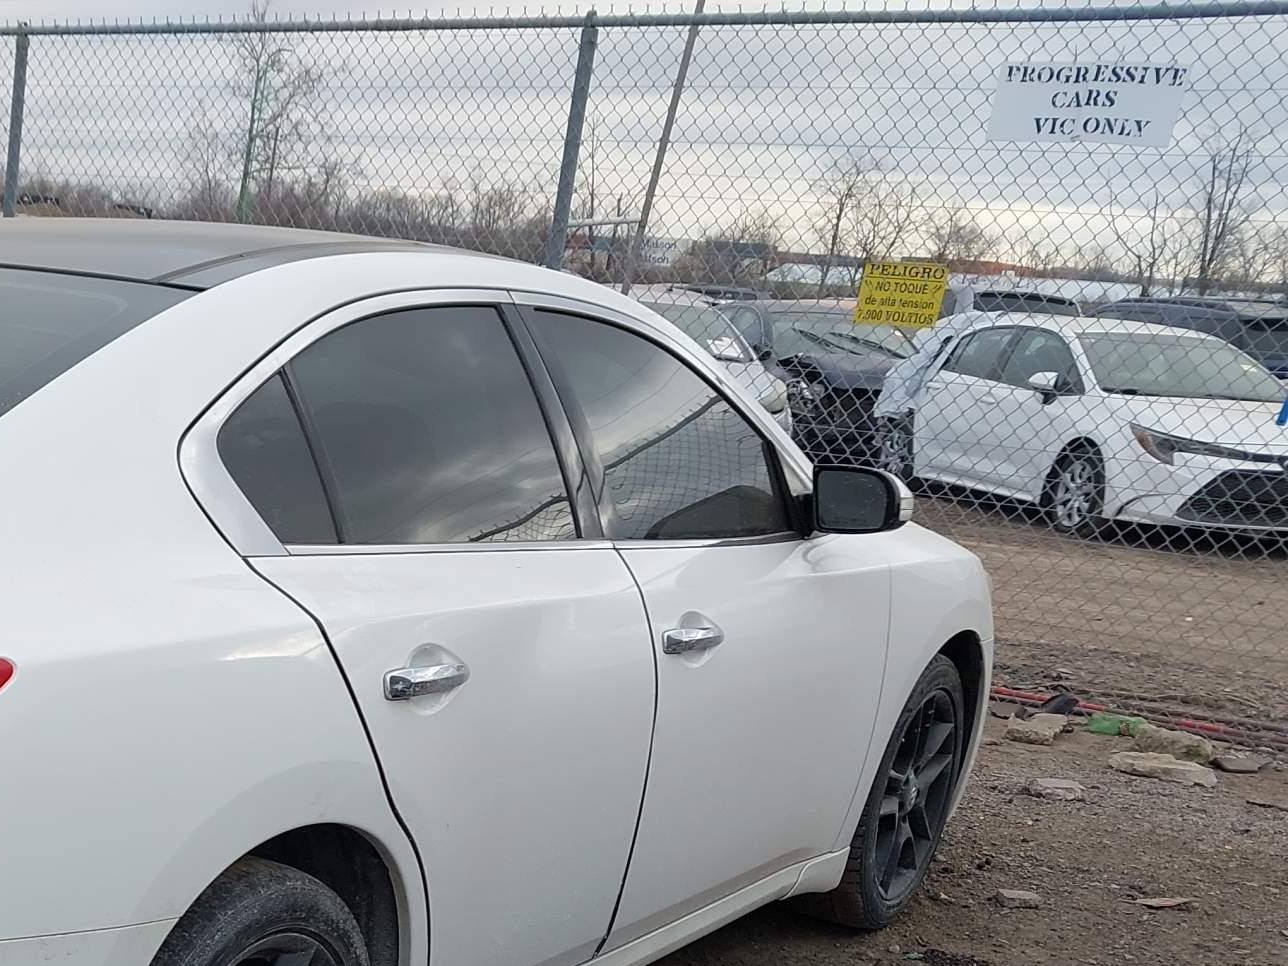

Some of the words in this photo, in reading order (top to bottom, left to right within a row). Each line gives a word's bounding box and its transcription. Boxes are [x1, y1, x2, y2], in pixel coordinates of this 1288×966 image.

[1005, 64, 1187, 87] PROGRESSIVE
[1051, 89, 1118, 108] CARS
[1034, 117, 1076, 136] VIC
[1082, 117, 1152, 138] ONLY
[869, 263, 945, 279] PELIGRO
[875, 281, 891, 292] NO
[894, 282, 929, 295] TOQUE
[865, 295, 877, 305] de
